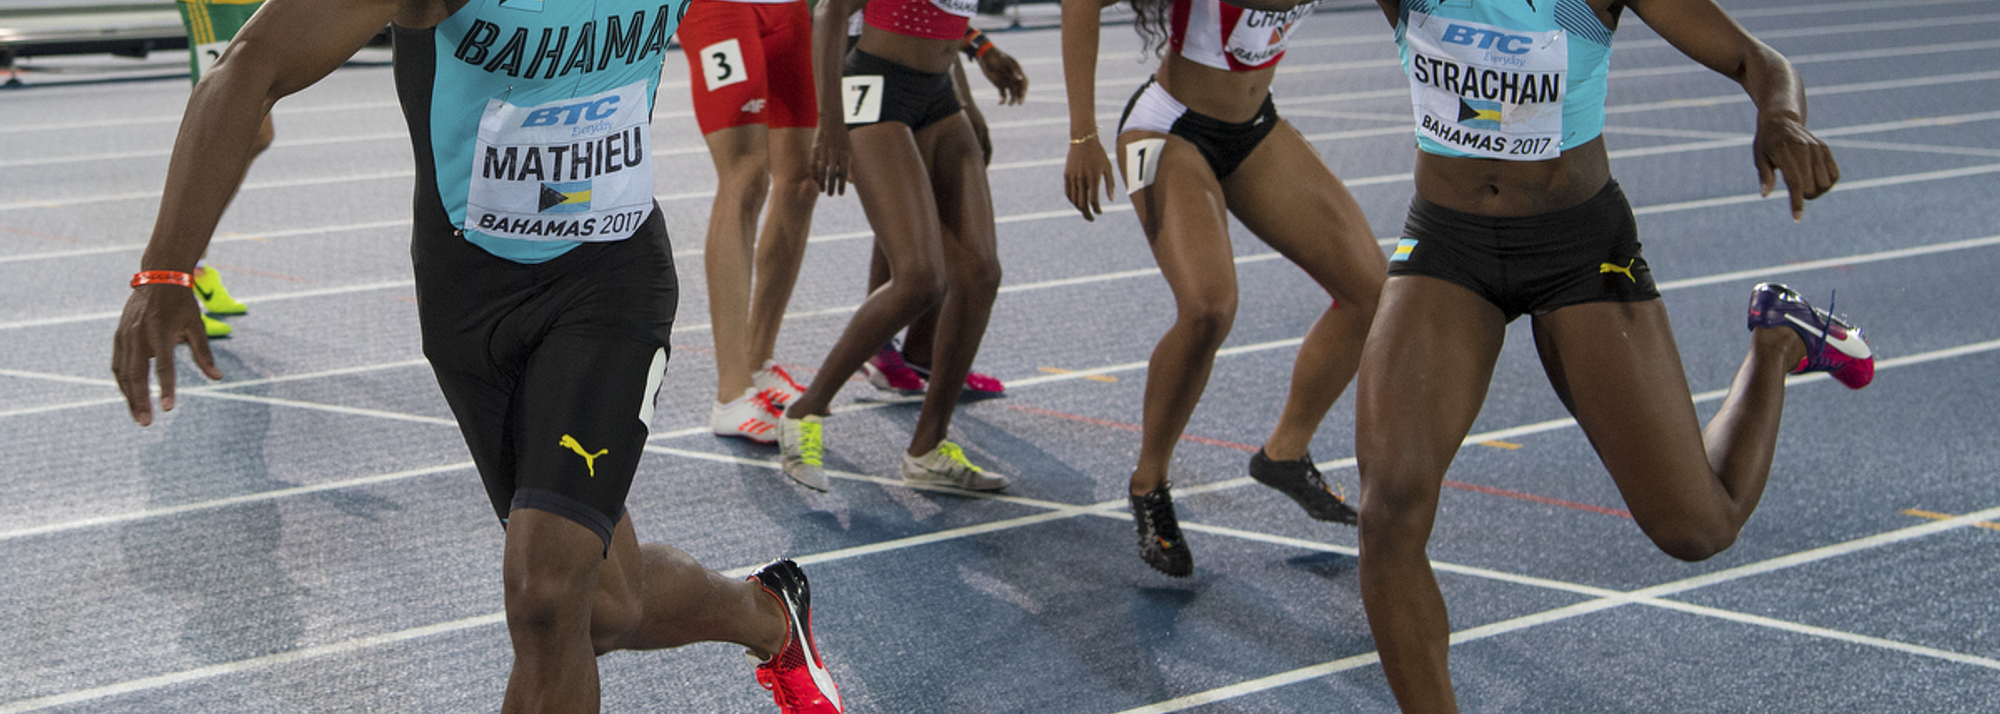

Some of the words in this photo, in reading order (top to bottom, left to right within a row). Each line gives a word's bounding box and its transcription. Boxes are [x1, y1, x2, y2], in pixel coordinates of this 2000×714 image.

[1441, 23, 1533, 55] BTC
[711, 52, 732, 81] 3
[1483, 52, 1527, 68] Everyday
[1414, 53, 1560, 105] STRACHAN
[520, 95, 621, 128] BTC
[851, 84, 872, 116] 7
[571, 119, 613, 137] Everyday
[1421, 114, 1507, 153] BAHAMAS
[1509, 138, 1551, 155] 2017
[482, 126, 643, 182] MATHIEU
[1137, 147, 1148, 181] 1
[478, 213, 597, 237] BAHAMAS
[600, 210, 643, 235] 2017
